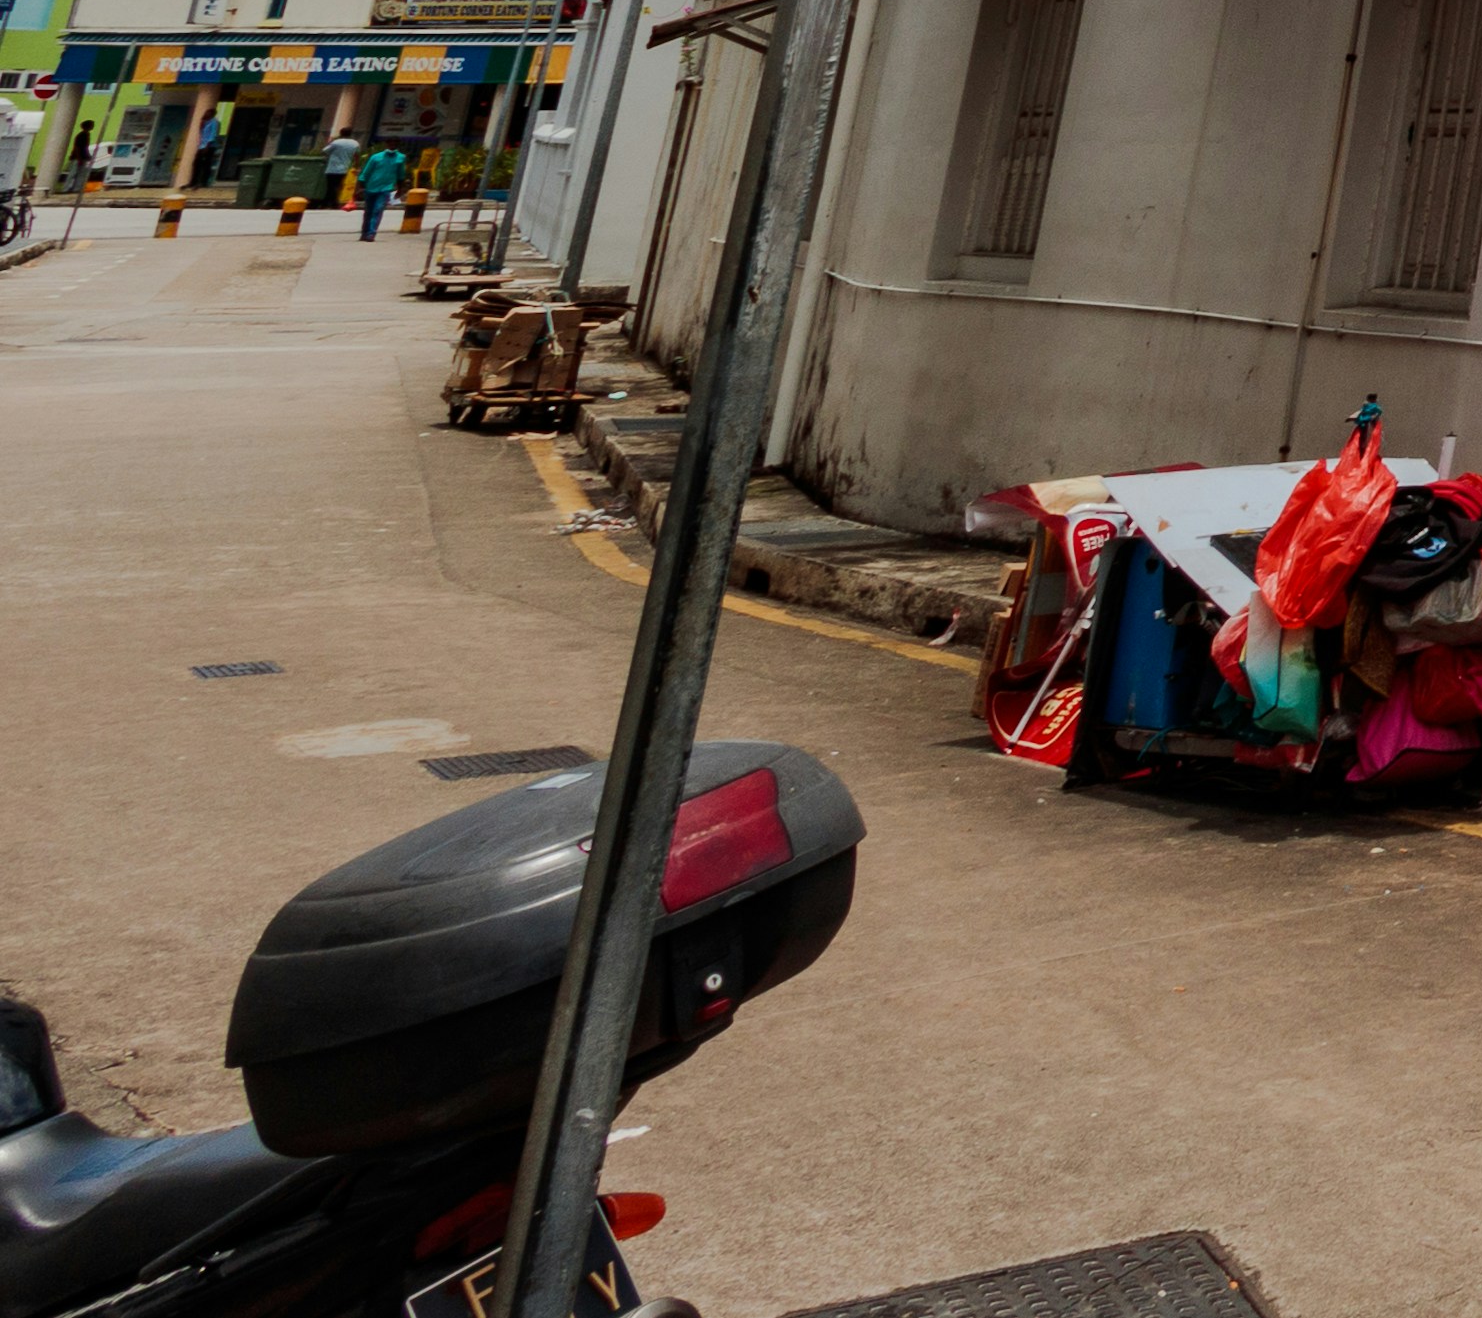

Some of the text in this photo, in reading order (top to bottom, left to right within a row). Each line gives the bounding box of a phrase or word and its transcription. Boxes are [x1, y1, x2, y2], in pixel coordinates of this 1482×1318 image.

[156, 56, 465, 73] FORTUNE CORNER EATING HOUSE
